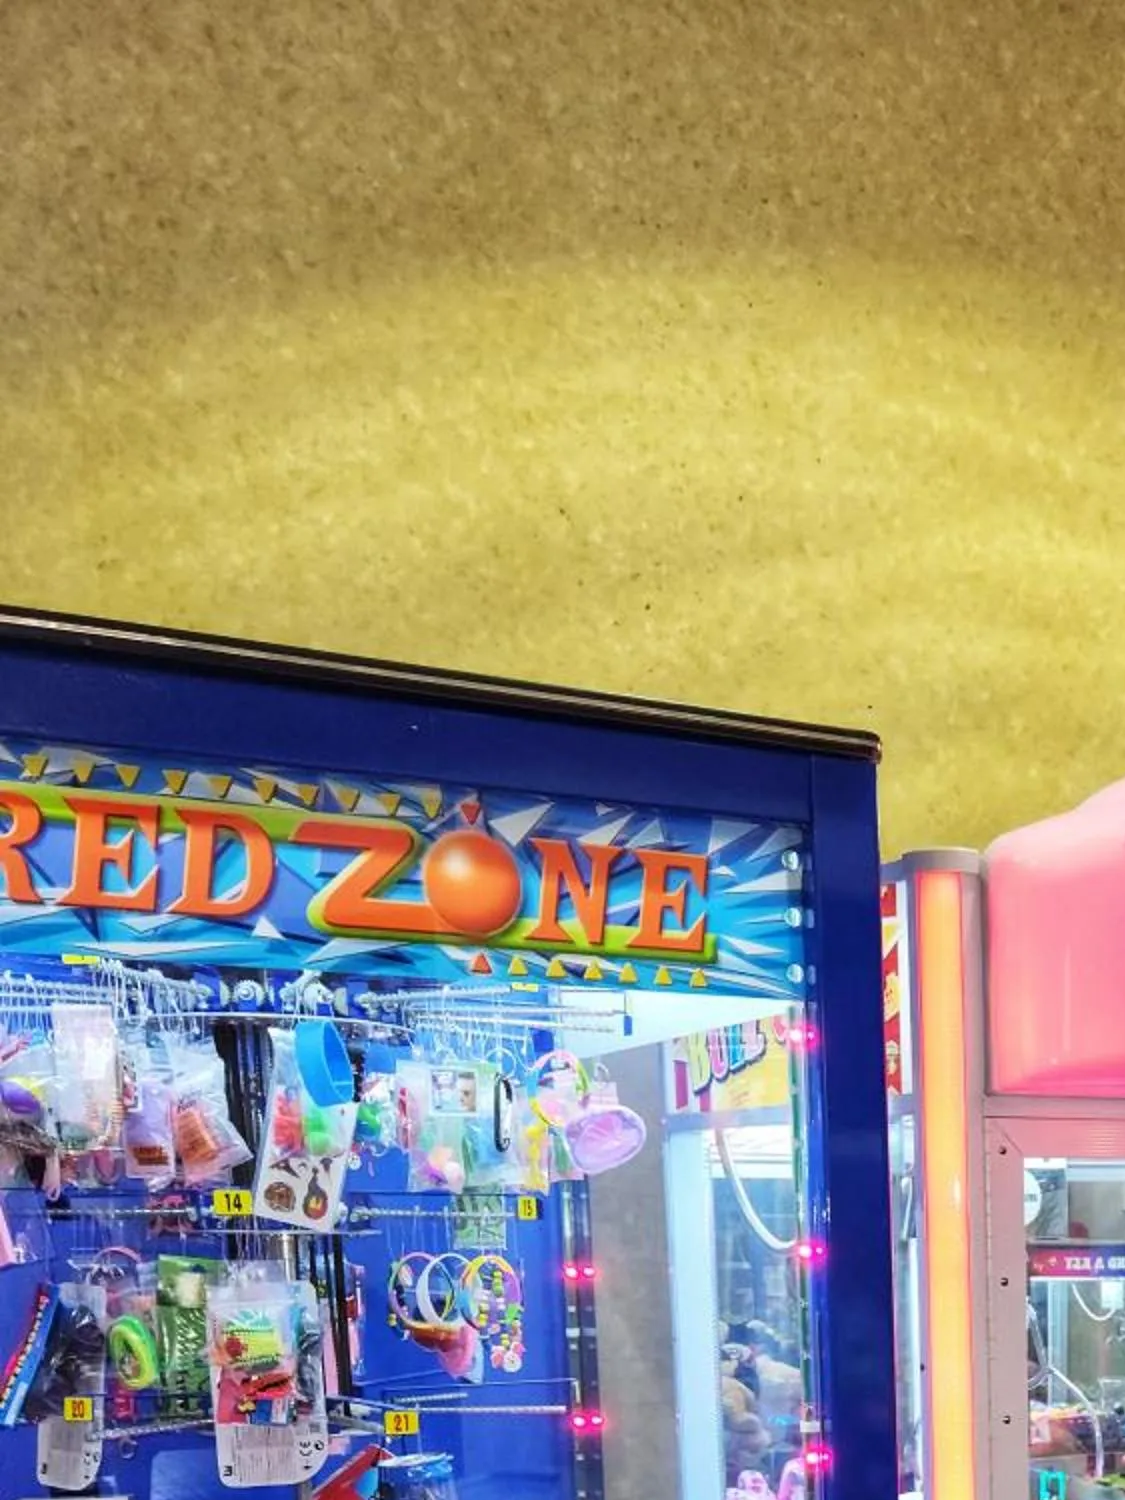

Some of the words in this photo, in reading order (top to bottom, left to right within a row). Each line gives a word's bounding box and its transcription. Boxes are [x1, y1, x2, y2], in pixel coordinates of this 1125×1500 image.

[288, 821, 707, 950] ZONE
[223, 1193, 242, 1210] 14
[393, 1414, 410, 1432] 21
